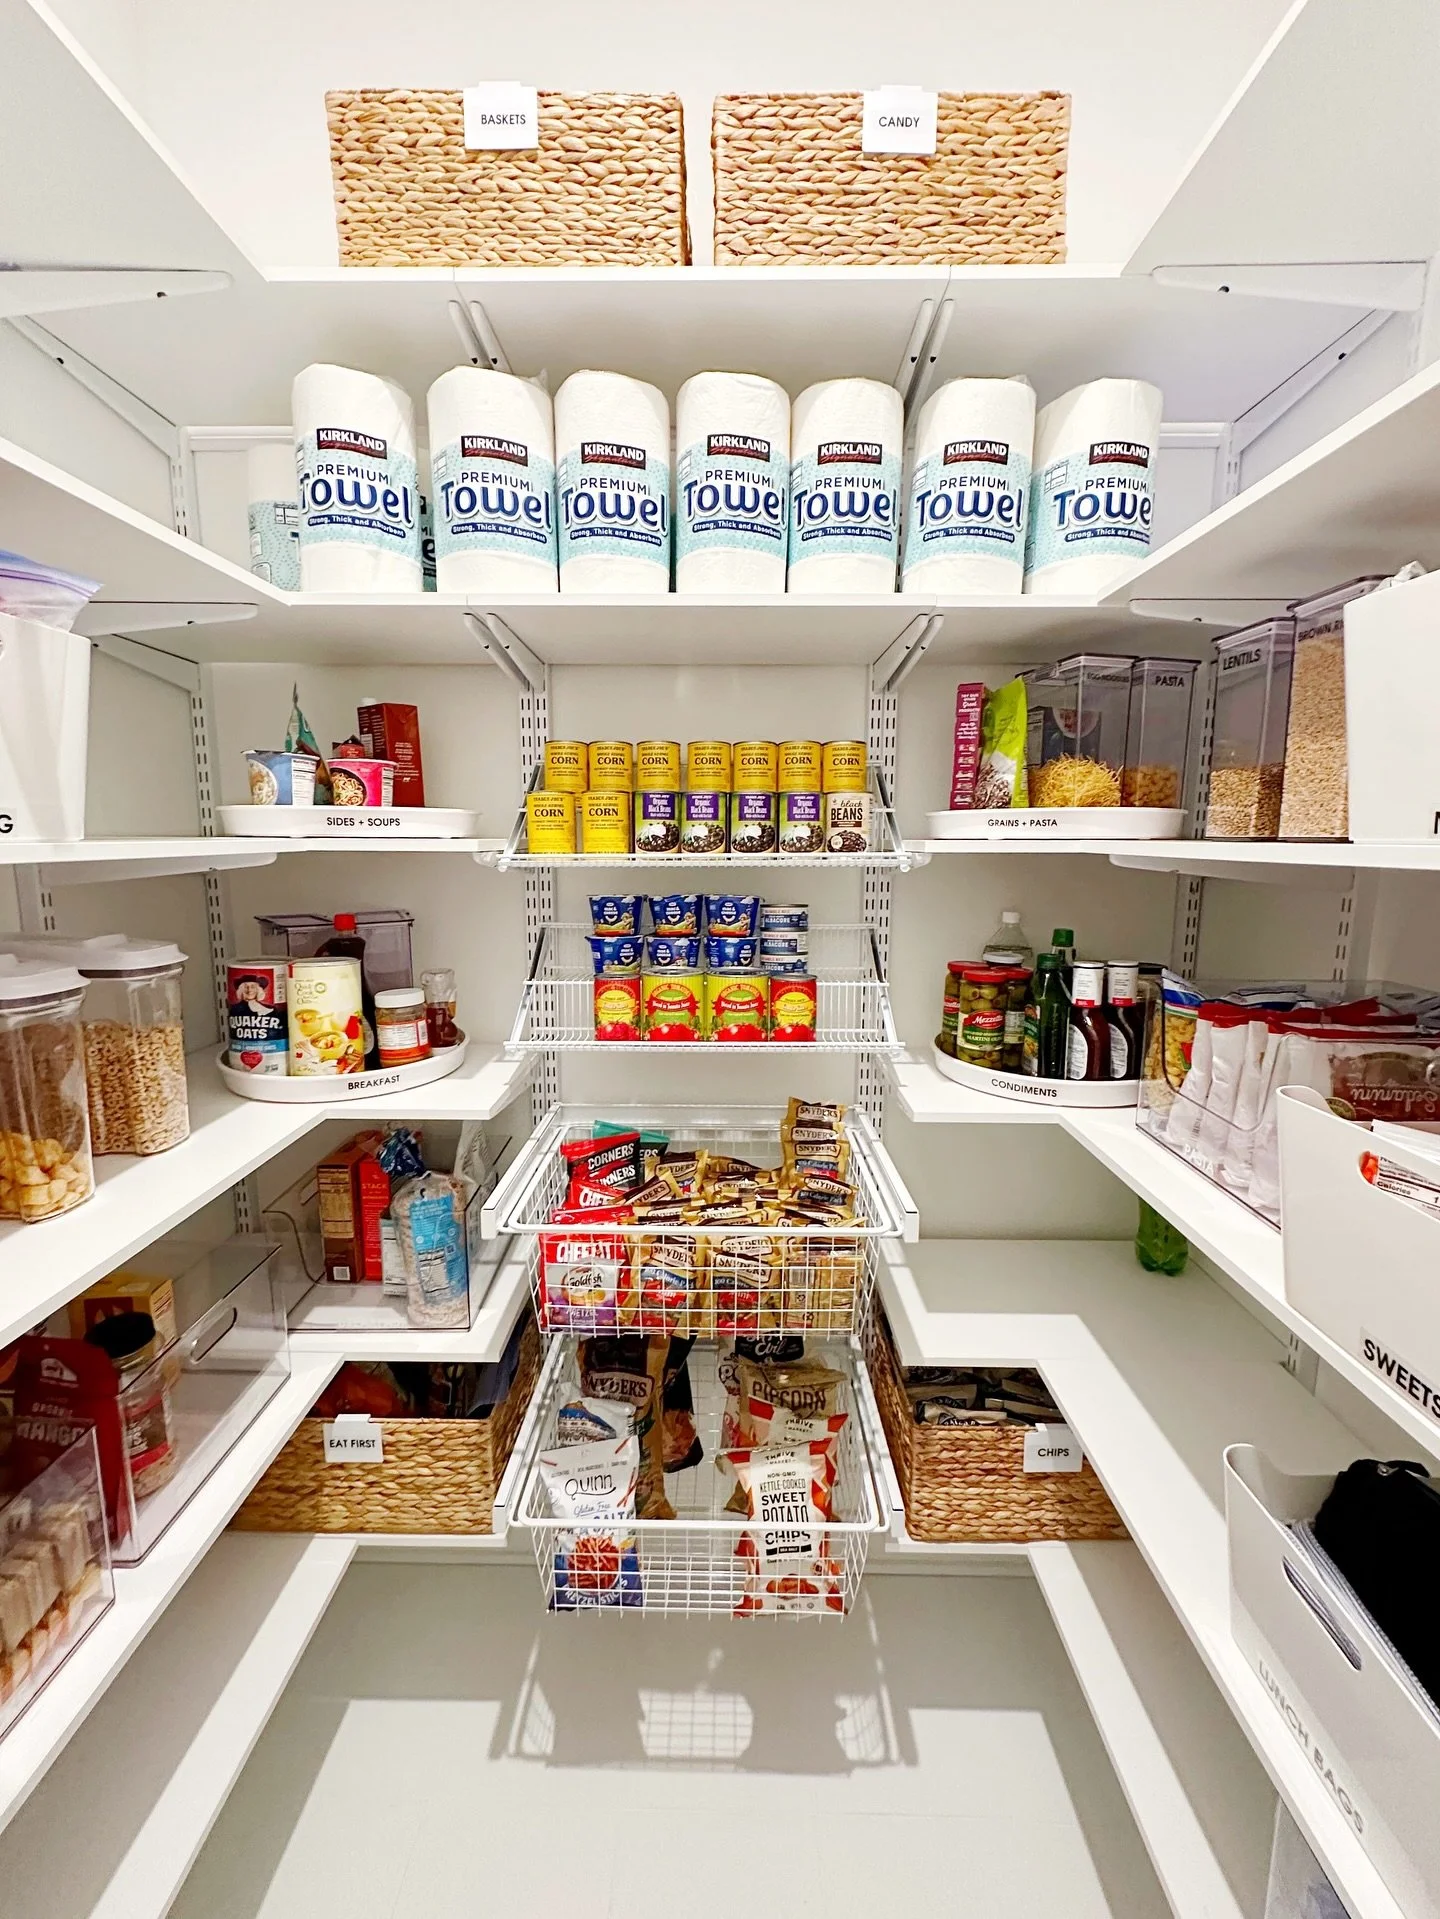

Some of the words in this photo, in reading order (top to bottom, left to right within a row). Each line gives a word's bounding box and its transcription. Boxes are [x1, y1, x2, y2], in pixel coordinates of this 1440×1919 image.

[481, 113, 527, 125] BASKETS
[878, 116, 920, 128] CANDY
[319, 430, 385, 451] KIRKLAND
[464, 437, 527, 458] KIRKLAND
[711, 435, 770, 453] KIRKLAND
[584, 444, 645, 461] KIRKLAND
[820, 443, 881, 456] KIRKLAND
[947, 442, 1007, 456] KIRKLAND
[1093, 444, 1149, 459] KIRKLAND
[317, 464, 390, 485] PREMIUM
[706, 470, 771, 488] PREMIUM
[461, 472, 530, 492] PREMIUM
[580, 477, 647, 495] PREMIUM
[815, 477, 882, 490] PREMIUM
[939, 476, 1007, 490] PREMIUM
[1085, 477, 1147, 491] PREMIUM
[441, 481, 551, 529] Towel
[562, 487, 666, 532] Towel
[684, 480, 785, 525] Towel
[794, 489, 896, 527] Towel
[916, 489, 1022, 528] Towel
[333, 516, 352, 524] Thick
[355, 518, 370, 527] and
[477, 523, 496, 531] Thick
[498, 525, 512, 533] and
[718, 520, 736, 529] Thick
[738, 522, 752, 530] and
[594, 528, 613, 536] Thick
[615, 529, 628, 537] and
[827, 527, 845, 535] Thick
[949, 527, 968, 535] Thick
[970, 527, 983, 535] and
[1096, 528, 1116, 536] Thick
[1223, 648, 1261, 671] LENTILS
[1155, 676, 1185, 688] PASTA
[551, 756, 580, 765] CORN
[597, 757, 625, 765] CORN
[642, 757, 669, 765] CORN
[695, 757, 722, 765] CORN
[785, 757, 812, 765] CORN
[832, 758, 860, 766] CORN
[534, 809, 565, 817] CORN
[588, 808, 619, 816] CORN
[831, 807, 863, 821] BEANS
[326, 817, 355, 827] SIDES
[367, 818, 401, 827] SOUPS
[988, 819, 1015, 827] GRAINS
[1025, 819, 1058, 827] PASTA
[229, 1015, 280, 1029] QUAKER
[236, 1028, 268, 1040] OATS
[348, 1075, 400, 1090] BREAKFAST
[991, 1078, 1057, 1098] CONDIMENTS
[587, 1142, 635, 1171] CORNERS
[1377, 1181, 1412, 1196] Calories
[755, 1339, 786, 1355] Evil
[1364, 1338, 1440, 1419] SWEETS
[785, 1418, 814, 1430] THRIVE
[329, 1439, 347, 1448] EAT
[350, 1439, 376, 1448] FIRST
[765, 1451, 796, 1461] THRIVE
[1037, 1448, 1070, 1457] CHIPS
[767, 1471, 797, 1479] NON-GMO
[565, 1474, 617, 1500] Quinn
[760, 1478, 807, 1492] KETTLE-COOKED
[761, 1492, 807, 1506] SWEET
[762, 1505, 809, 1523] POTATO
[764, 1530, 811, 1546] CHIPS
[1259, 1660, 1309, 1748] LUNCH
[1313, 1746, 1364, 1835] BAGS
